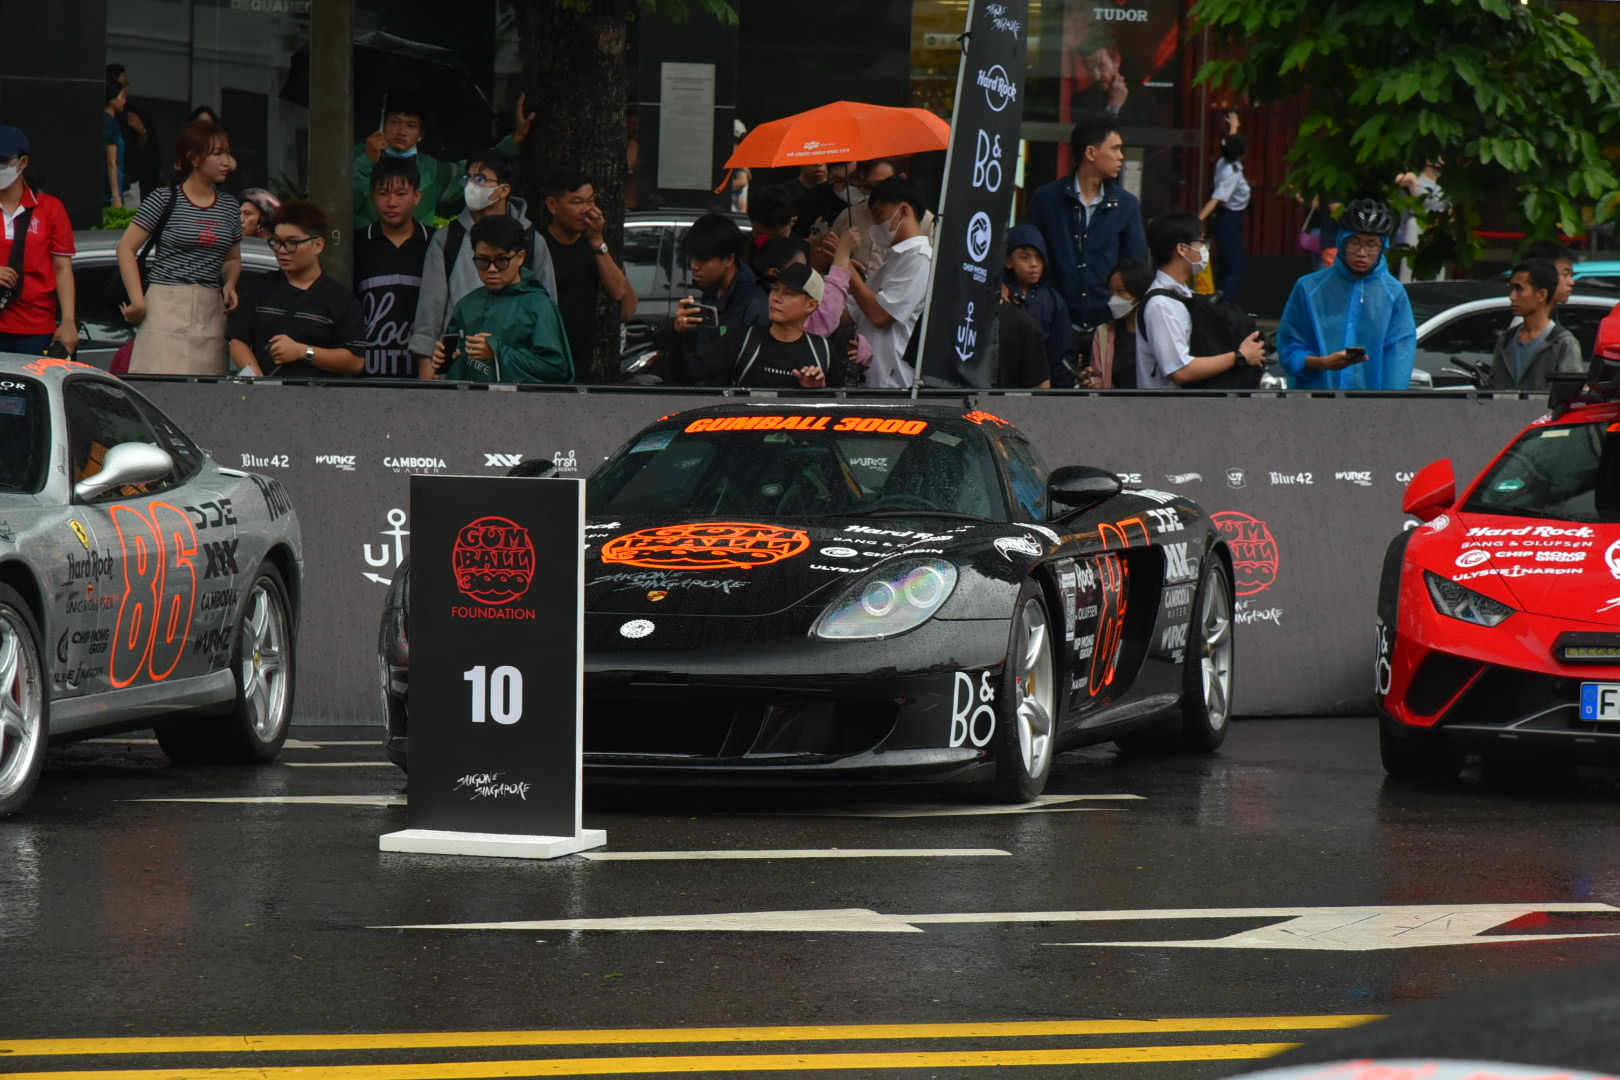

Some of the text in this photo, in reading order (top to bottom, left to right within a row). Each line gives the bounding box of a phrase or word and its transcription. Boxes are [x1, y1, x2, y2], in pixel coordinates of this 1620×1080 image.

[1093, 8, 1148, 21] TUDOR
[977, 69, 1017, 102] Hard Rock
[365, 349, 412, 375] UITT
[684, 416, 928, 435] GUMBALL 3000
[315, 455, 356, 465] WURKZ
[383, 456, 447, 469] CAMBODIA
[552, 449, 577, 468] frsh
[1335, 471, 1372, 481] WURKZ
[844, 525, 914, 541] Hard
[1466, 526, 1533, 537] Hard
[1461, 540, 1505, 549] BANG
[1525, 540, 1593, 548] OLUFSEN
[67, 548, 114, 582] Hard Rock
[456, 549, 531, 571] BALL
[1074, 560, 1097, 592] Rock
[1452, 568, 1511, 581] ULYSSE
[110, 502, 198, 688] 86
[613, 579, 751, 595] SINGAPORE
[201, 587, 237, 611] CAMBODIA
[1165, 587, 1190, 608] CAMBODIA
[451, 606, 536, 620] FOUNDATION
[1235, 607, 1284, 626] INGAPORE
[1161, 622, 1188, 650] WURKZ
[464, 665, 523, 725] 10
[1586, 705, 1593, 714] D
[470, 781, 532, 801] SINGAPORE
